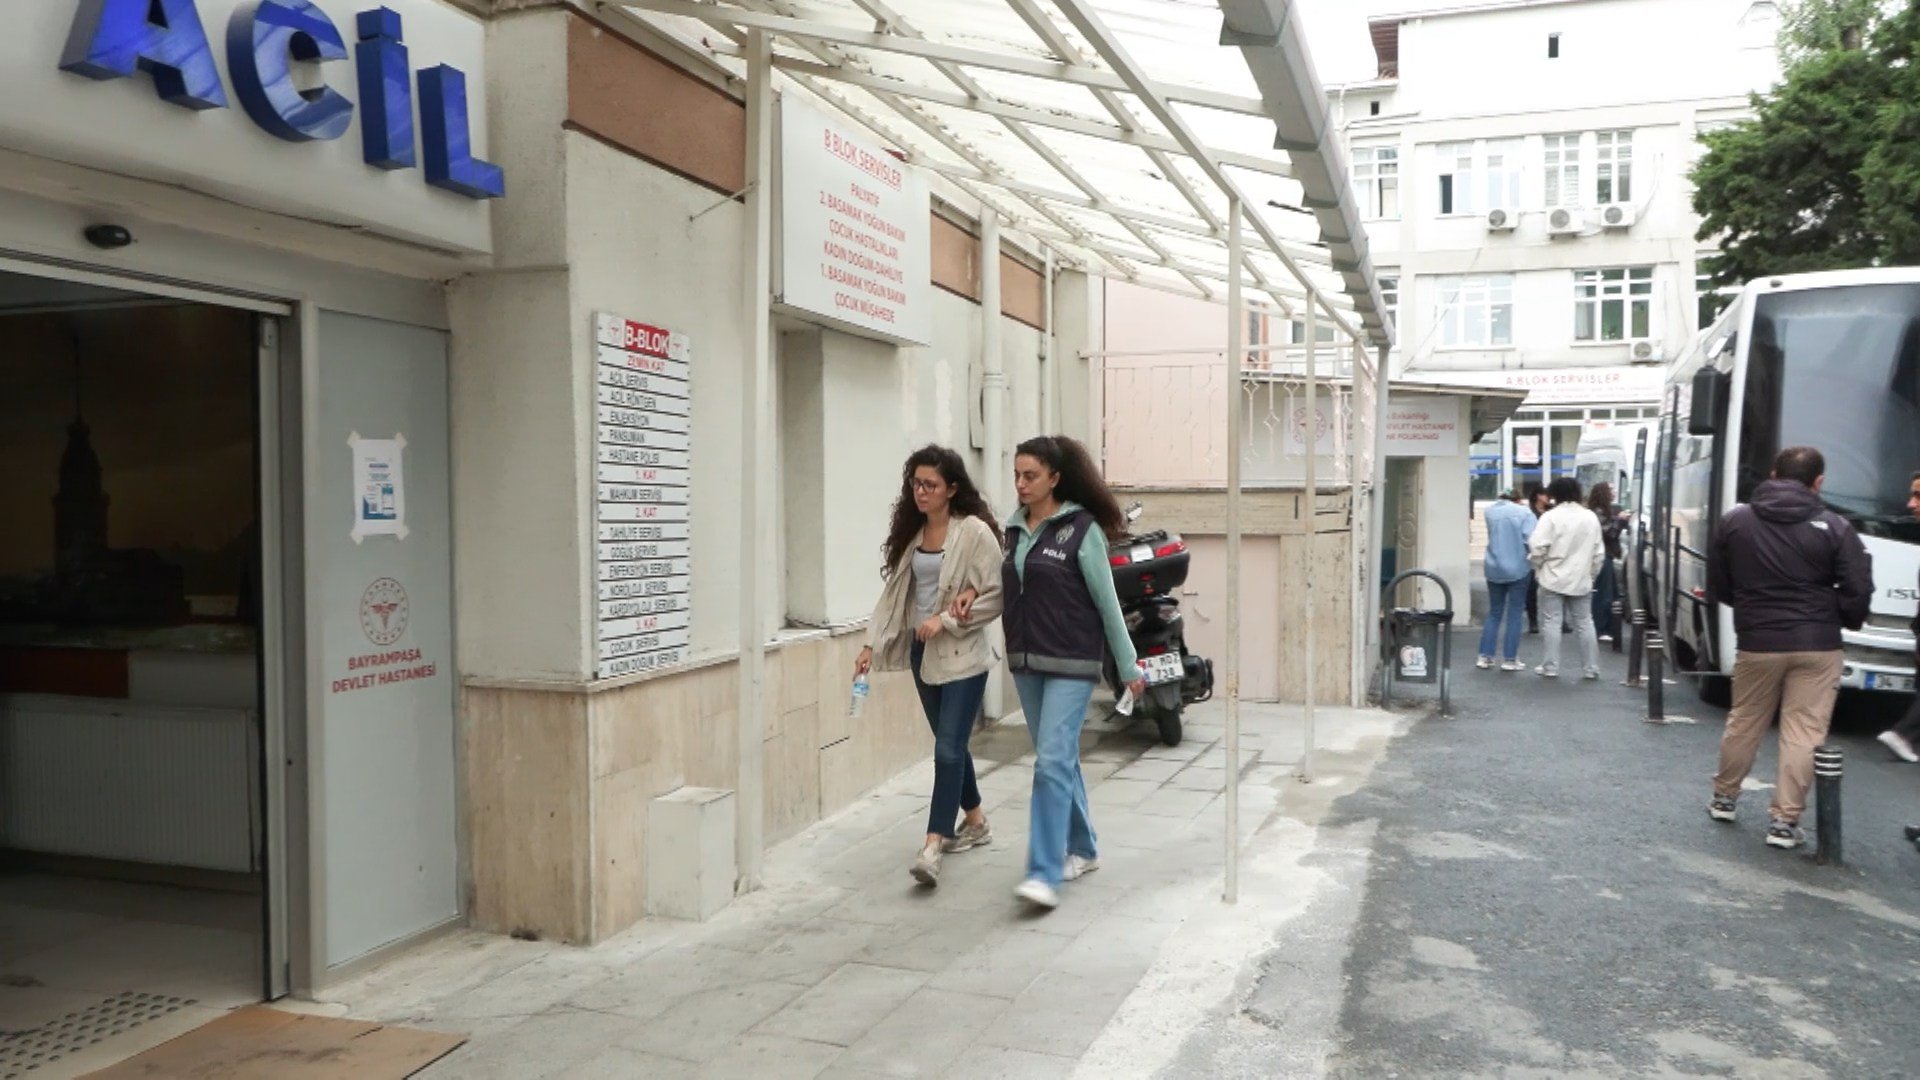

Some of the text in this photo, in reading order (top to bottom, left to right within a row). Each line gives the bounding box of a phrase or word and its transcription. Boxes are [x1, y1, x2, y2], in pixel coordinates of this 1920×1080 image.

[59, 0, 506, 200] ACİL
[824, 128, 831, 147] B
[833, 132, 857, 164] BLOK
[820, 190, 826, 205] 2.
[828, 193, 862, 220] BASAMAK
[829, 218, 854, 239] ÇOCUK
[824, 240, 847, 261] KADIN
[820, 263, 827, 278] 1.
[828, 264, 863, 290] BASAMAK
[834, 291, 859, 313] ÇOCUK
[626, 325, 670, 354] B-BLOK
[651, 359, 666, 372] KAT
[609, 429, 645, 444] PANSUMAN
[609, 449, 639, 462] HASTANE
[643, 470, 657, 480] KAT
[609, 487, 637, 500] MAHKUM
[643, 507, 657, 518] KAT
[643, 617, 657, 630] KAT
[348, 648, 422, 670] BAYRAMPAŞA
[332, 661, 436, 694] DEVLET HASTANESİ
